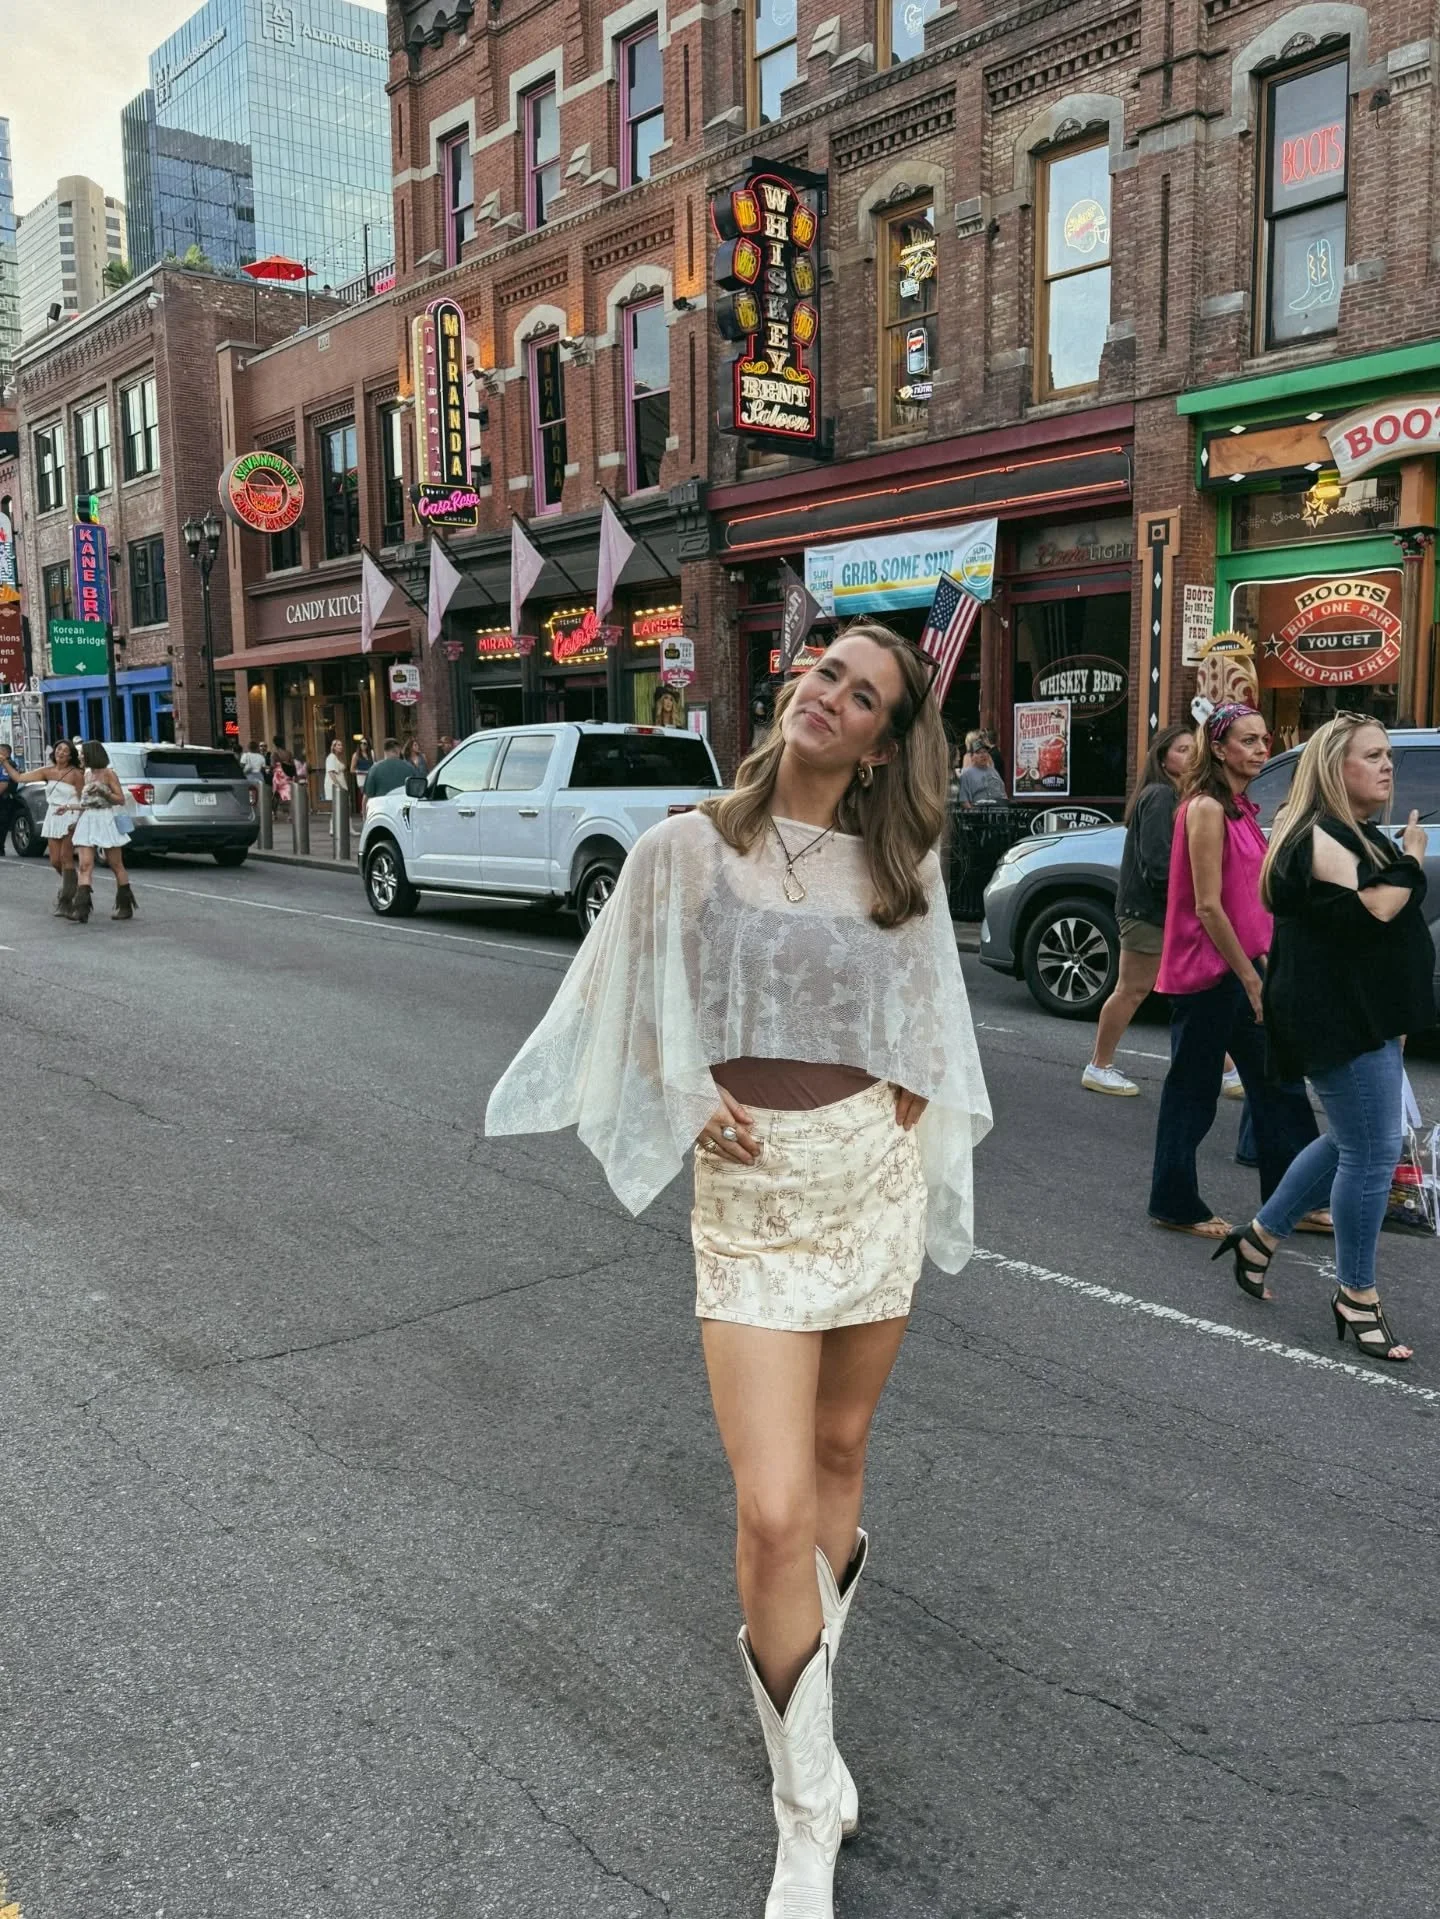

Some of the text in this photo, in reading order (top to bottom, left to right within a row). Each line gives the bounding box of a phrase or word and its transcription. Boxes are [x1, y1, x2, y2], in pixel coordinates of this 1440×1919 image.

[302, 26, 389, 62] ALLIANCEBER
[1282, 124, 1344, 185] BOOTS
[762, 183, 790, 374] WHISKEY
[443, 313, 463, 476] MIRANDA
[741, 375, 810, 408] BENT
[741, 399, 810, 432] Saloon
[1344, 406, 1440, 460] BOO
[233, 453, 298, 486] SAVANNAH'S
[232, 491, 301, 530] CANDY KITCHEN
[418, 490, 480, 517] Casa Rosa
[444, 515, 473, 523] CANTINA
[79, 529, 97, 582] KANE
[842, 549, 955, 588] GRAB SOME SUN
[286, 600, 326, 624] CANDY
[1186, 588, 1213, 603] BOOTS
[1298, 583, 1386, 609] BOOTS
[53, 625, 85, 635] Korean
[632, 617, 683, 636] LAMBE
[1287, 602, 1393, 637] BUY ONE PAIR
[54, 636, 106, 646] Vets Bridge
[1307, 634, 1371, 648] YOU GET
[1286, 647, 1395, 683] TWO PAIR FREE
[1039, 669, 1123, 696] WHISKEY BENT
[1020, 712, 1052, 729] COWBOY
[1022, 724, 1061, 740] HYDRATION
